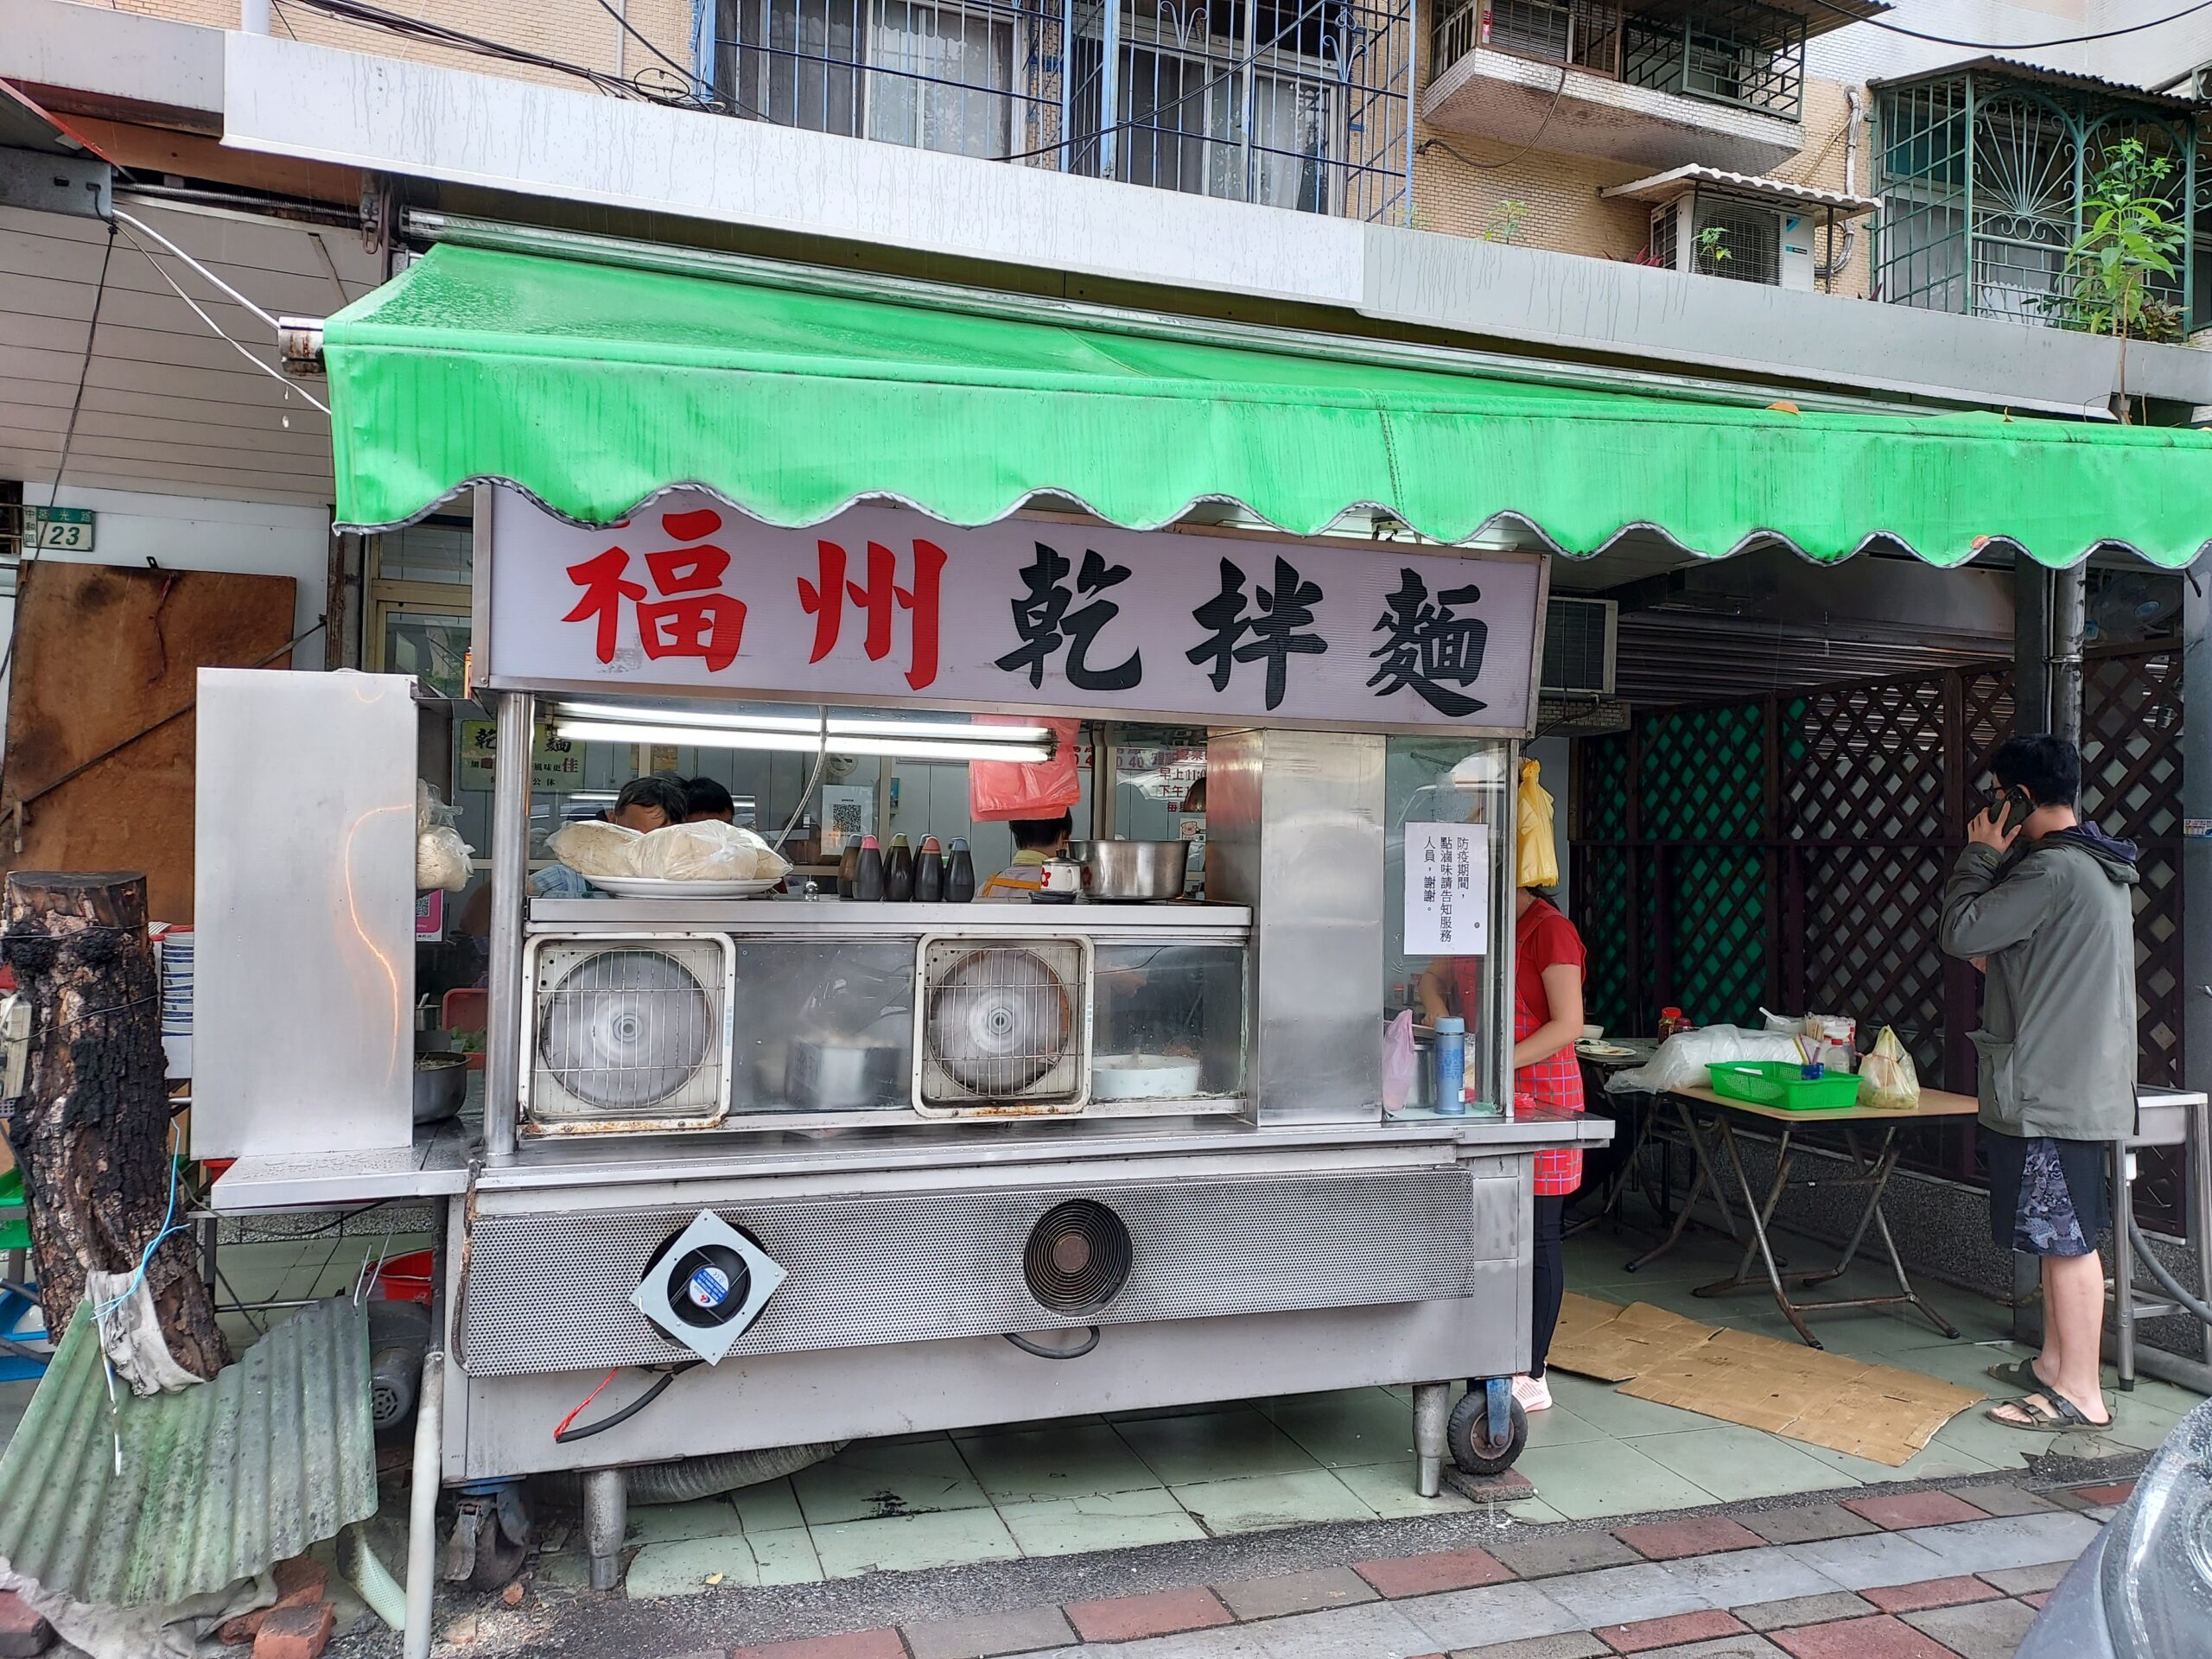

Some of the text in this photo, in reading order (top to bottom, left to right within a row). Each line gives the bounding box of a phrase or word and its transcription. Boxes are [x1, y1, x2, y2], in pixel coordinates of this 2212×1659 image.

[49, 525, 80, 546] 23
[562, 508, 1489, 717] 福州乾拌麵
[532, 757, 579, 772] 風味更佳
[1440, 836, 1453, 944] 點滷味請告知服務
